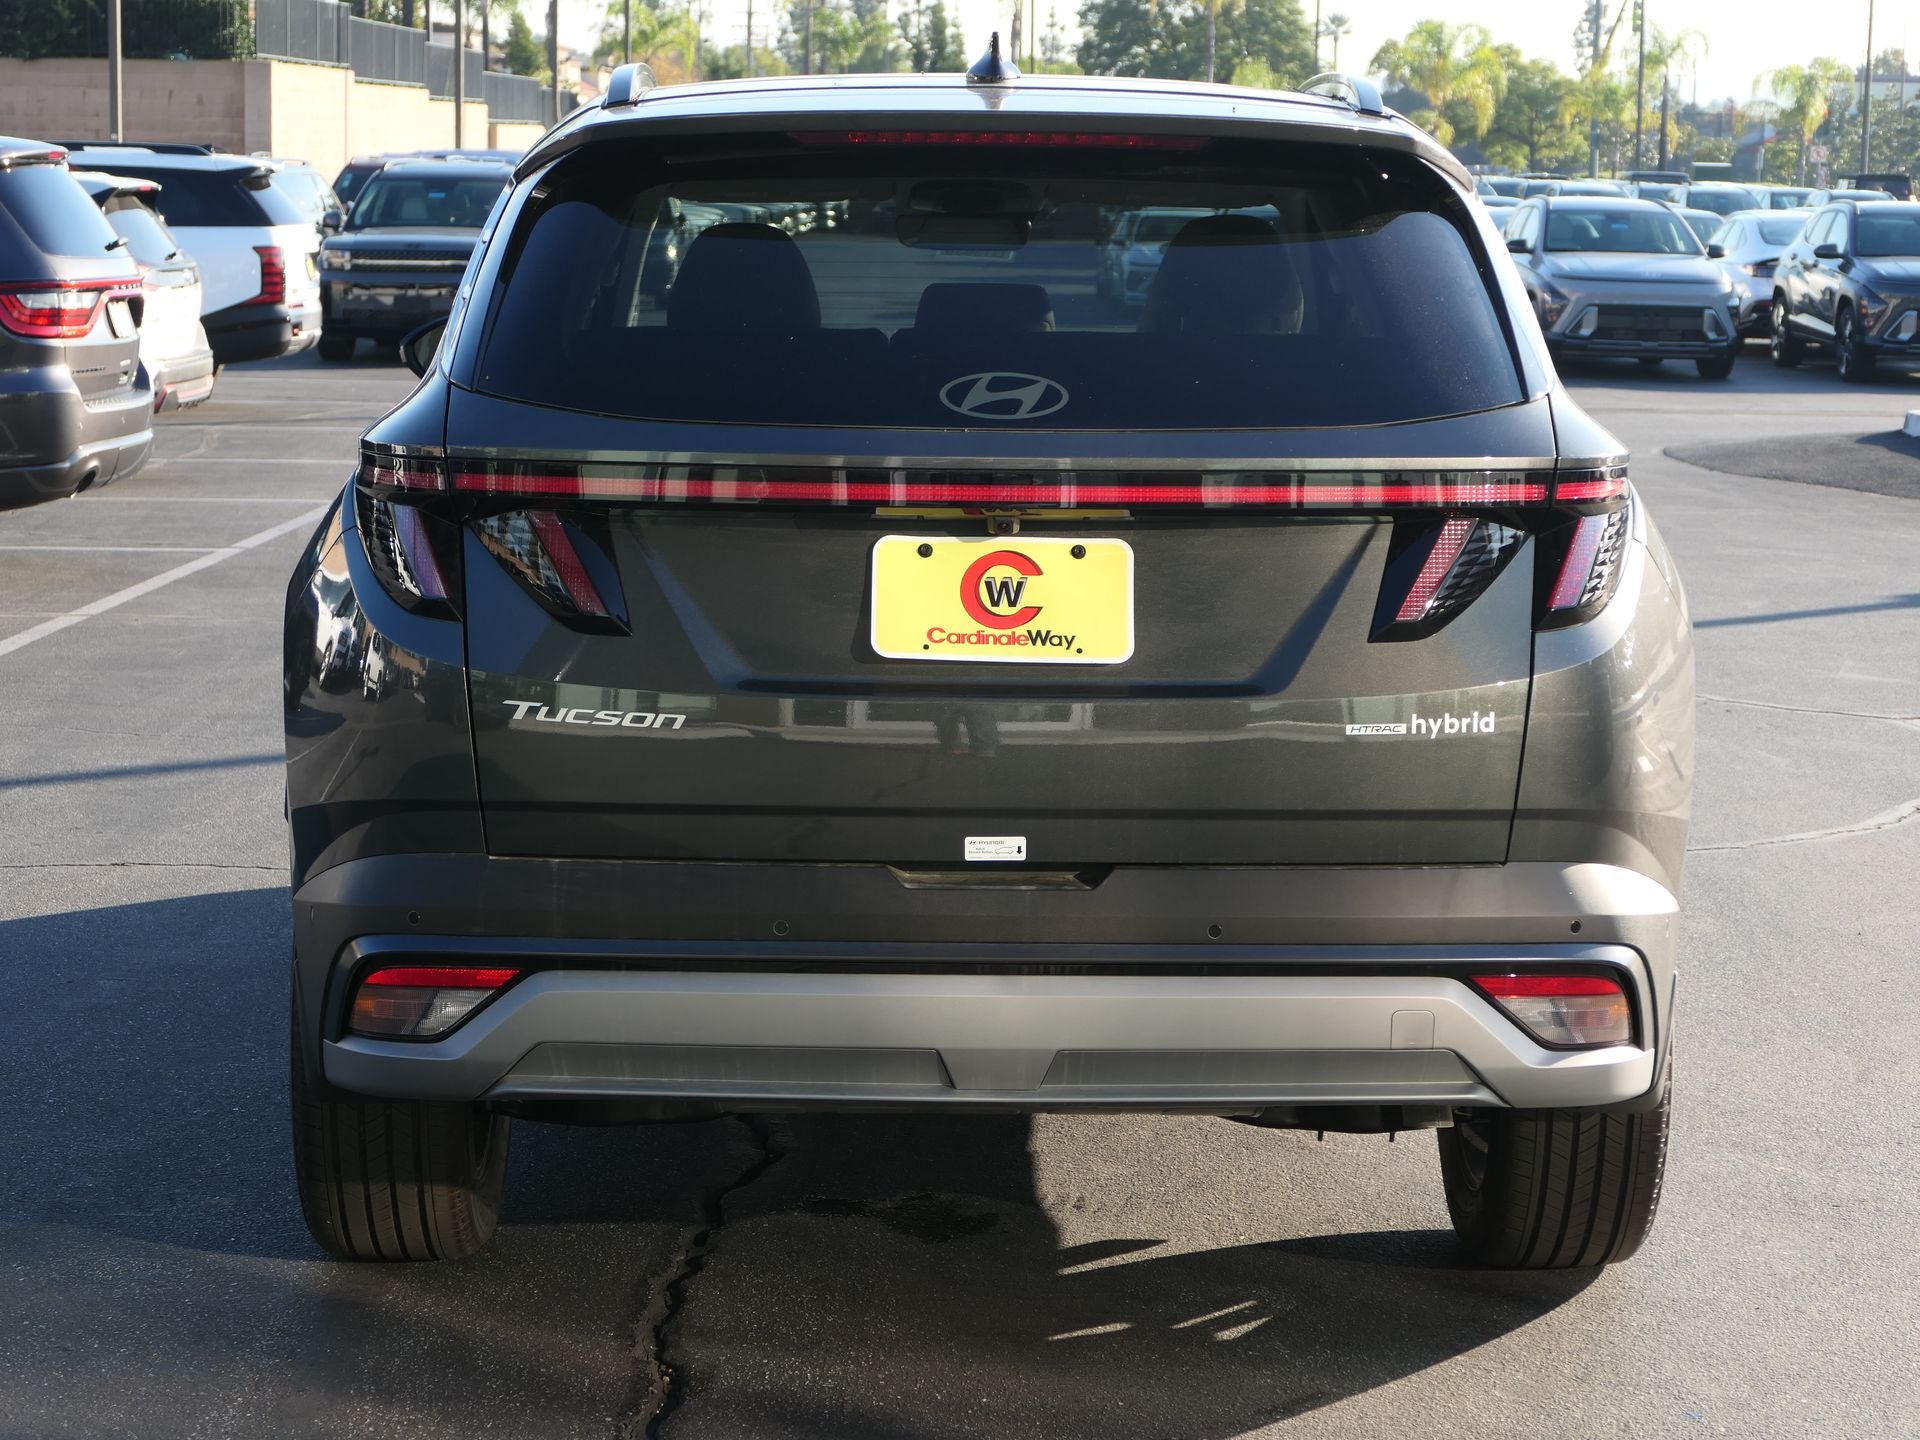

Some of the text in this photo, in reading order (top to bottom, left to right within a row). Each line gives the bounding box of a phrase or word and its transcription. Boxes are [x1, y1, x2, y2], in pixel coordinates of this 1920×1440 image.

[926, 627, 1076, 650] CardinaleWay
[1350, 711, 1496, 739] HTRAC hybrid
